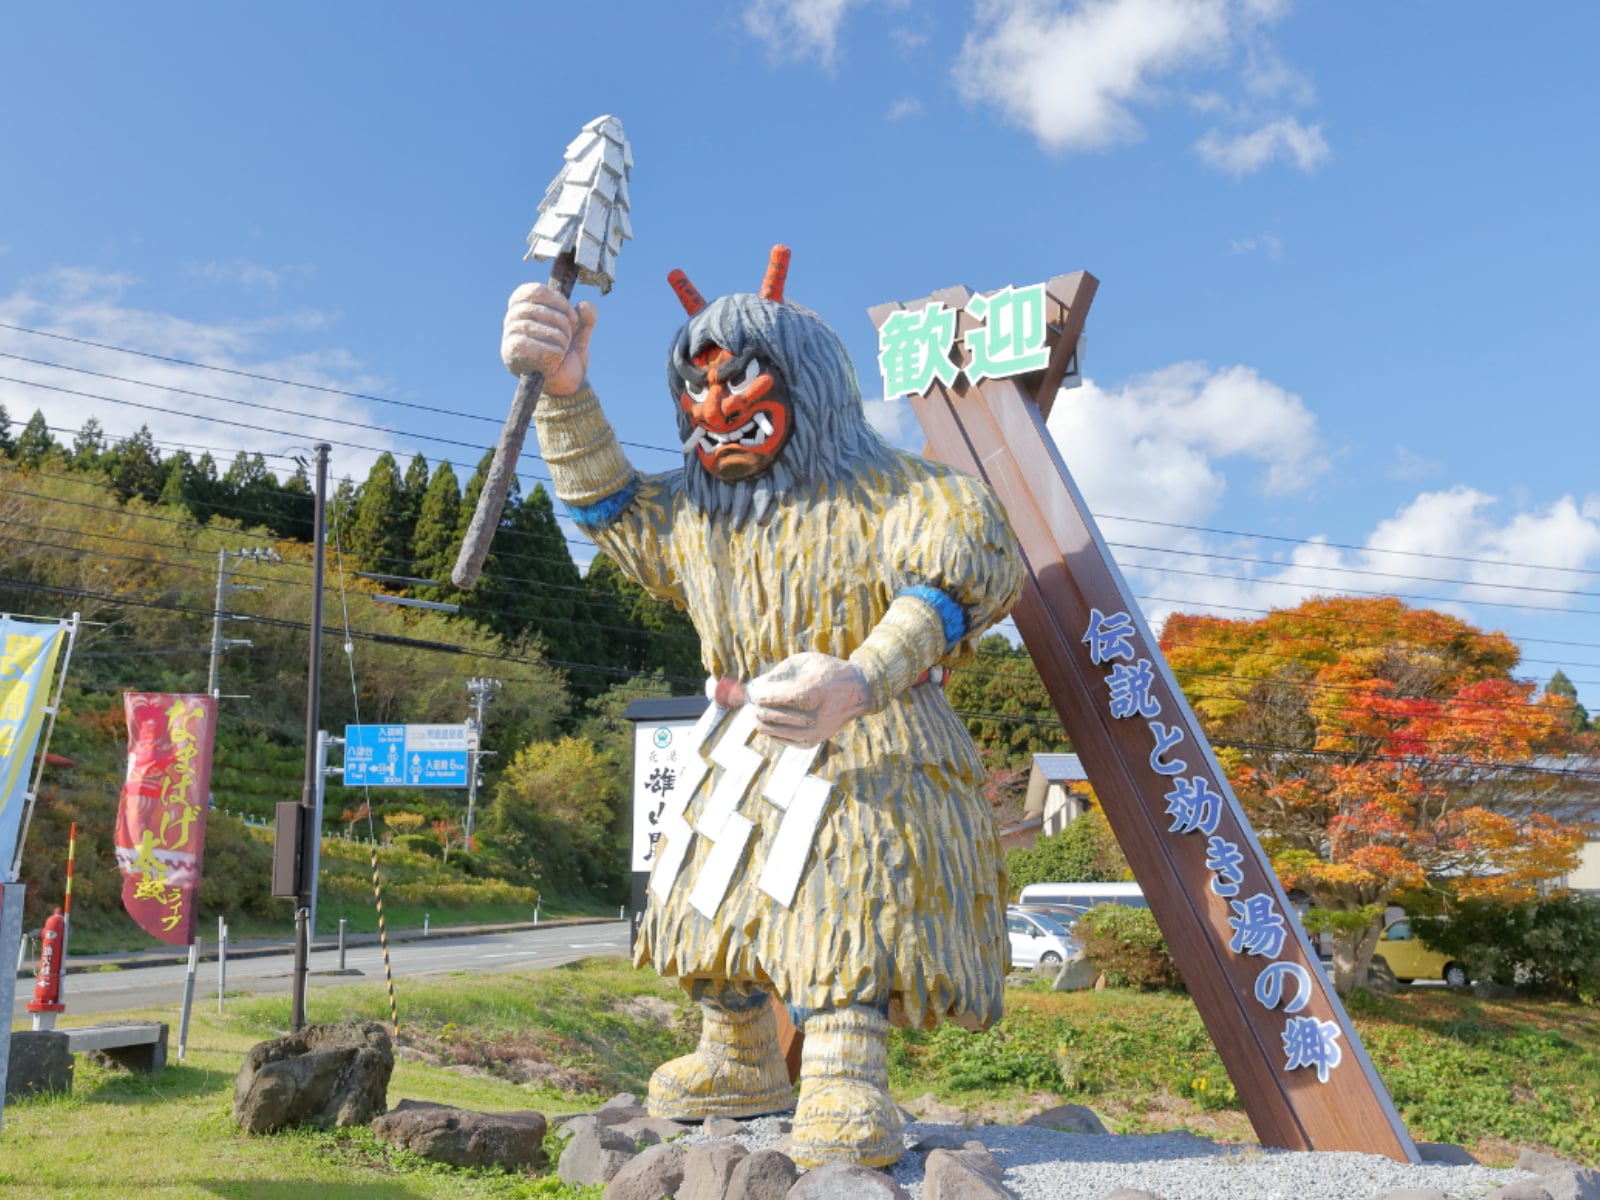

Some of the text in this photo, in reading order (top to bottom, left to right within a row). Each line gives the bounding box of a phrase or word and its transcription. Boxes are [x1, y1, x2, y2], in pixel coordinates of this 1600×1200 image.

[879, 283, 1050, 400] 歓迎
[160, 699, 204, 850] なまはげ
[132, 830, 168, 904] 太鼓
[1084, 608, 1341, 1083] 伝説と効き湯の郷
